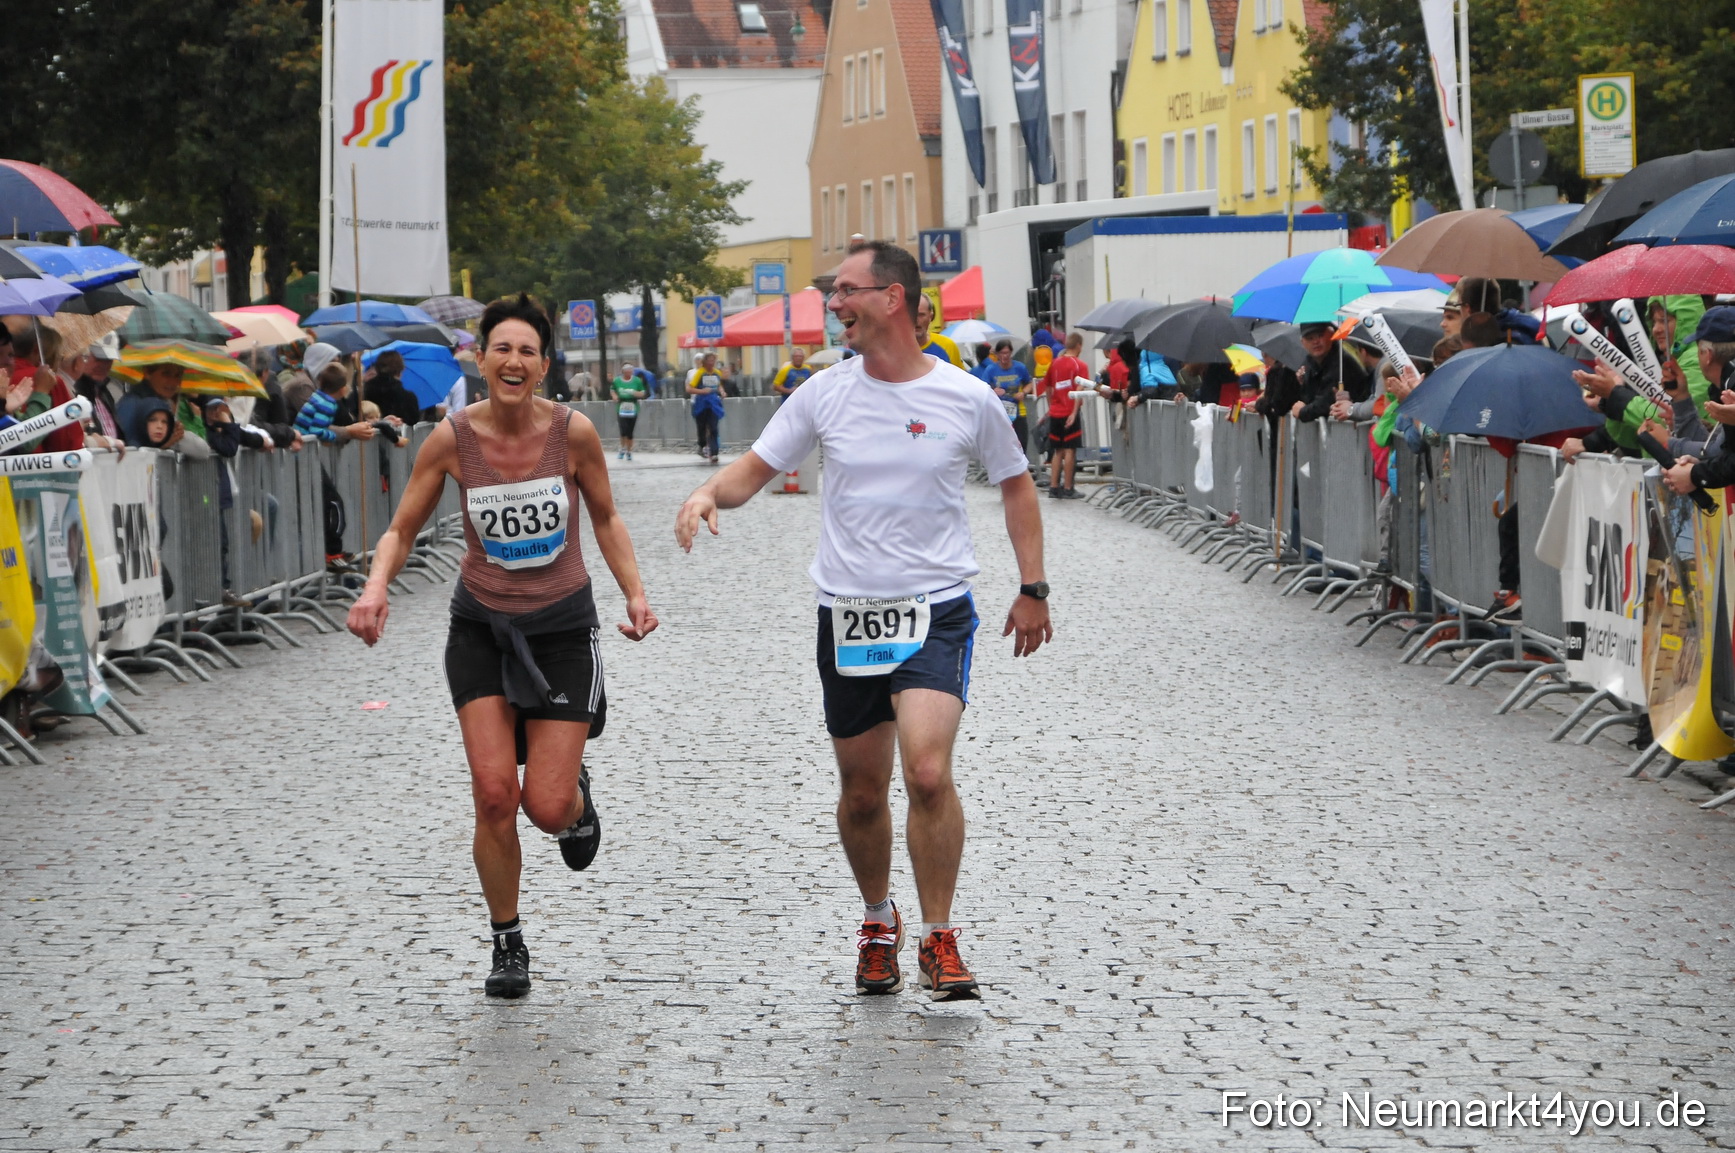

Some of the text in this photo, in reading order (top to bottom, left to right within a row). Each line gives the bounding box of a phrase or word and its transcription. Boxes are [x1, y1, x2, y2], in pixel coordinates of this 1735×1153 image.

[1168, 92, 1194, 121] HOTEL
[1522, 112, 1570, 124] Ulmer Gasse
[1591, 124, 1625, 132] Marktplatz
[395, 219, 440, 231] neumarkt
[572, 327, 594, 336] TAXI
[698, 325, 721, 335] TAXI
[1590, 335, 1627, 368] BMW
[12, 455, 53, 472] BMW
[470, 488, 549, 506] PARTL Neumarkt
[480, 500, 560, 538] 2633
[501, 542, 549, 559] Claudia
[835, 596, 864, 606] PARTL
[843, 607, 917, 641] 2691
[867, 647, 894, 663] Frank
